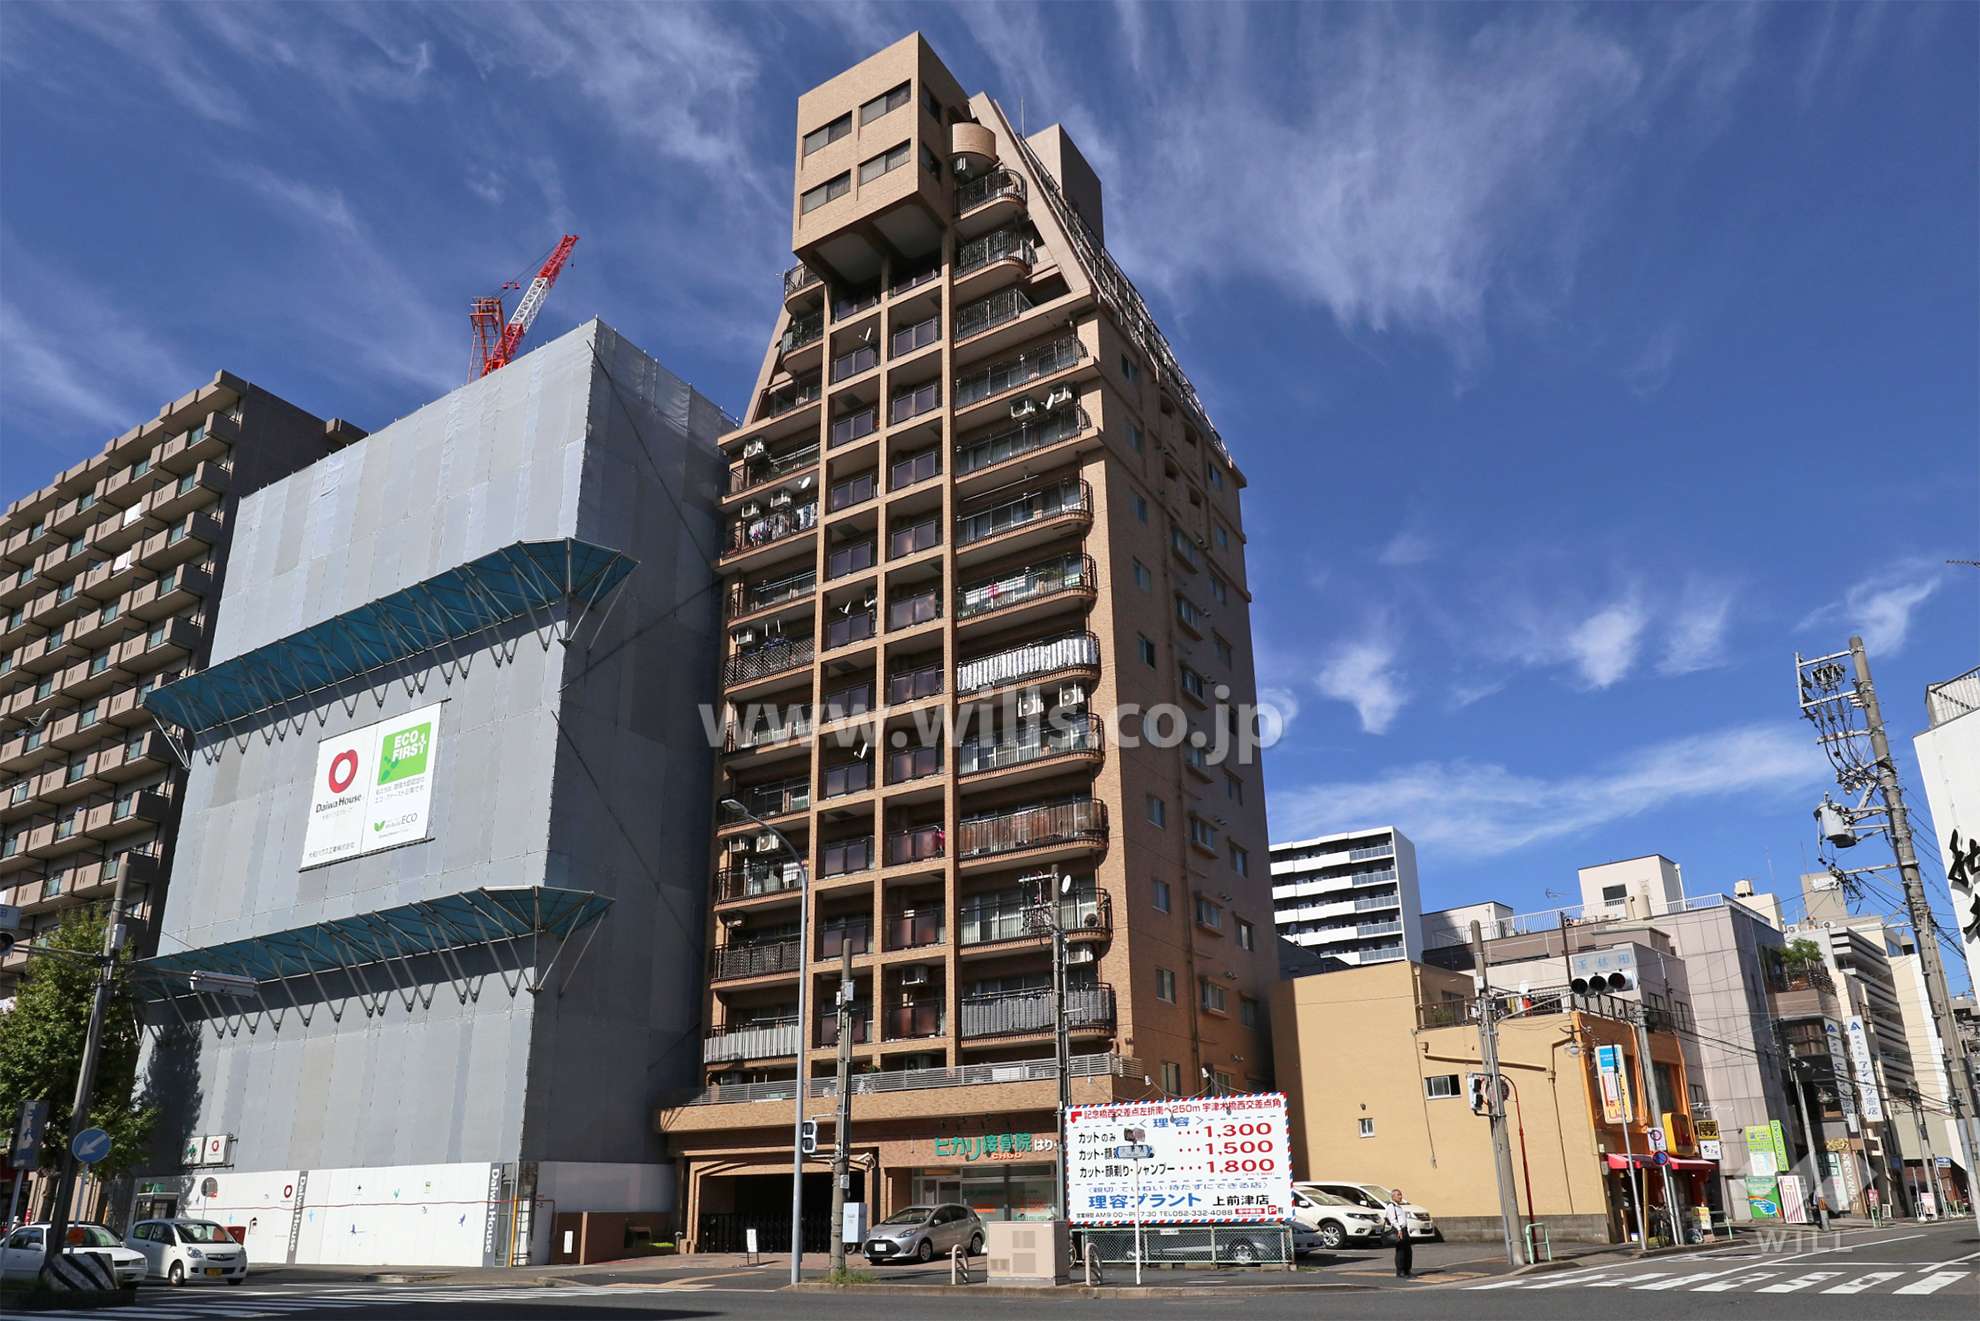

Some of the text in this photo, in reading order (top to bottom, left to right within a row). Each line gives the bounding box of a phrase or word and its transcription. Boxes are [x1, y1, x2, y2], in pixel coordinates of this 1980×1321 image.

[394, 730, 418, 748] ECO
[391, 741, 427, 762] FIRST
[315, 800, 338, 813] Daiwa
[338, 794, 362, 807] House
[401, 812, 418, 824] ECO
[485, 1168, 500, 1253] Daiwa House
[1088, 1193, 1269, 1209] 理容プラント 上前津店
[289, 1176, 307, 1251] Daiwa House
